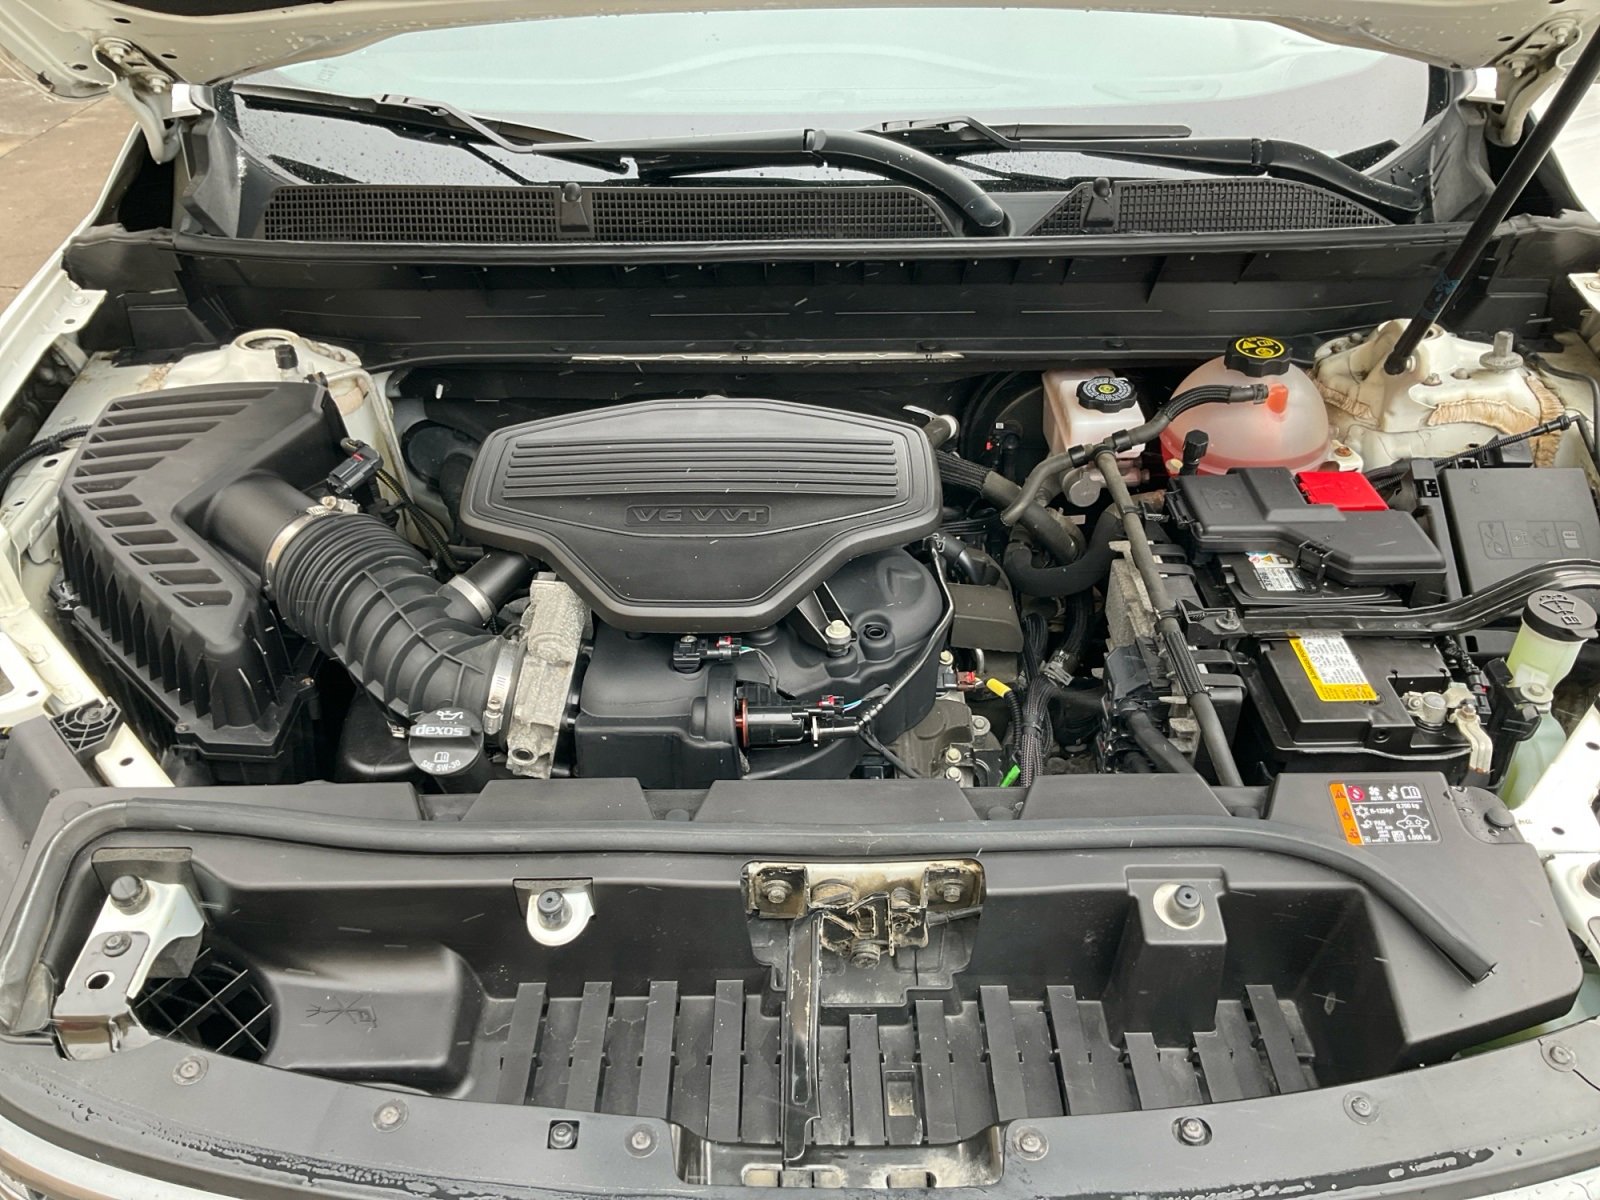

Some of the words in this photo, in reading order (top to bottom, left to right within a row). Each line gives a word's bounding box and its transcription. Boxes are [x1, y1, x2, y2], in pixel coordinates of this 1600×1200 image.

[632, 508, 682, 522] V6
[689, 508, 766, 522] VVT
[415, 724, 465, 736] dexos
[436, 759, 461, 772] 5W-30
